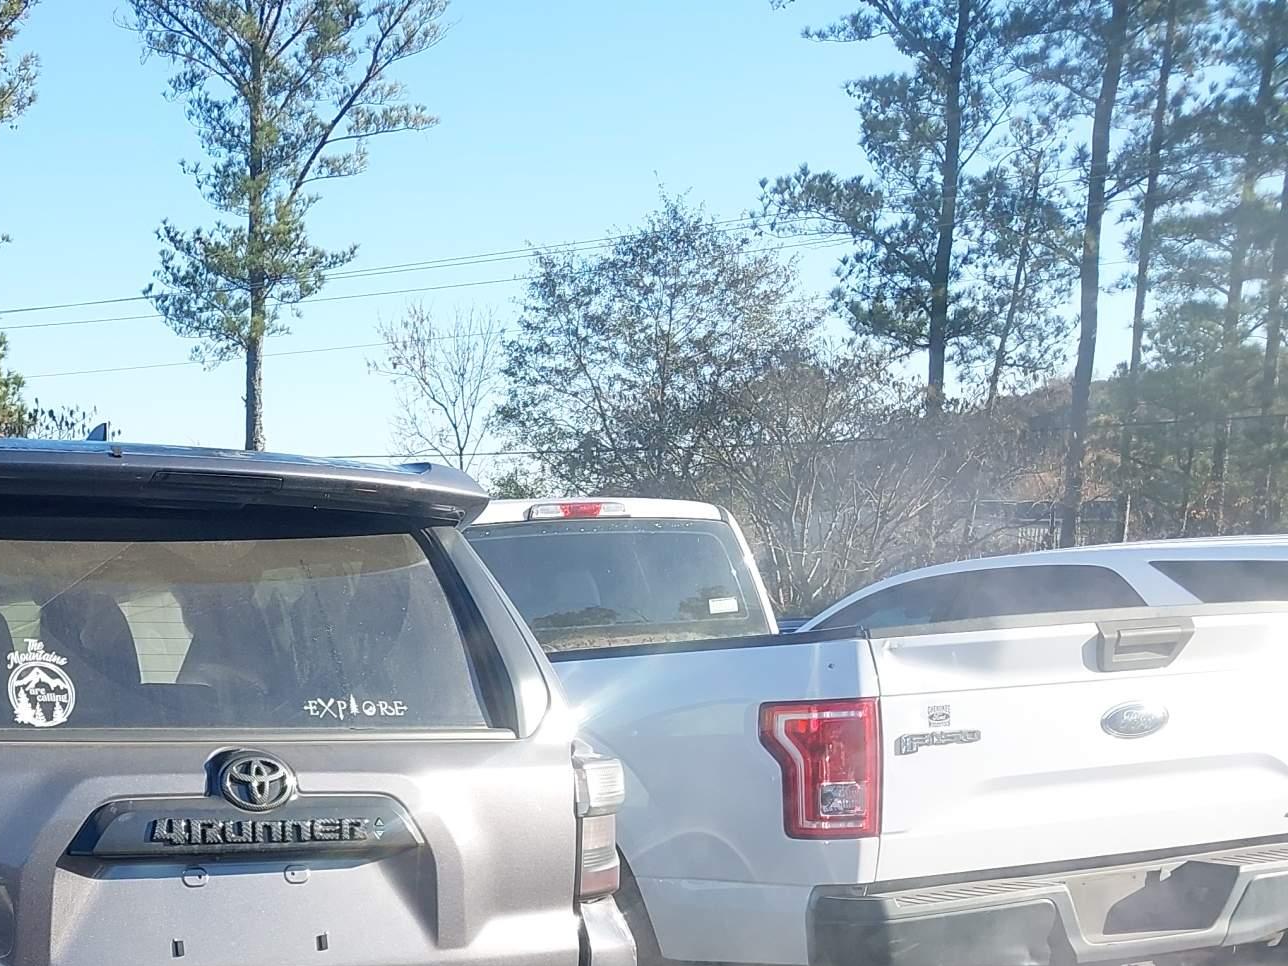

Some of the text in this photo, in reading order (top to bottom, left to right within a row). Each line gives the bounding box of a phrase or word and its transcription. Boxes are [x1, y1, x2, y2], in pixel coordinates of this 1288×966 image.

[24, 638, 44, 653] The
[7, 650, 68, 670] Mountains
[37, 692, 68, 703] calling
